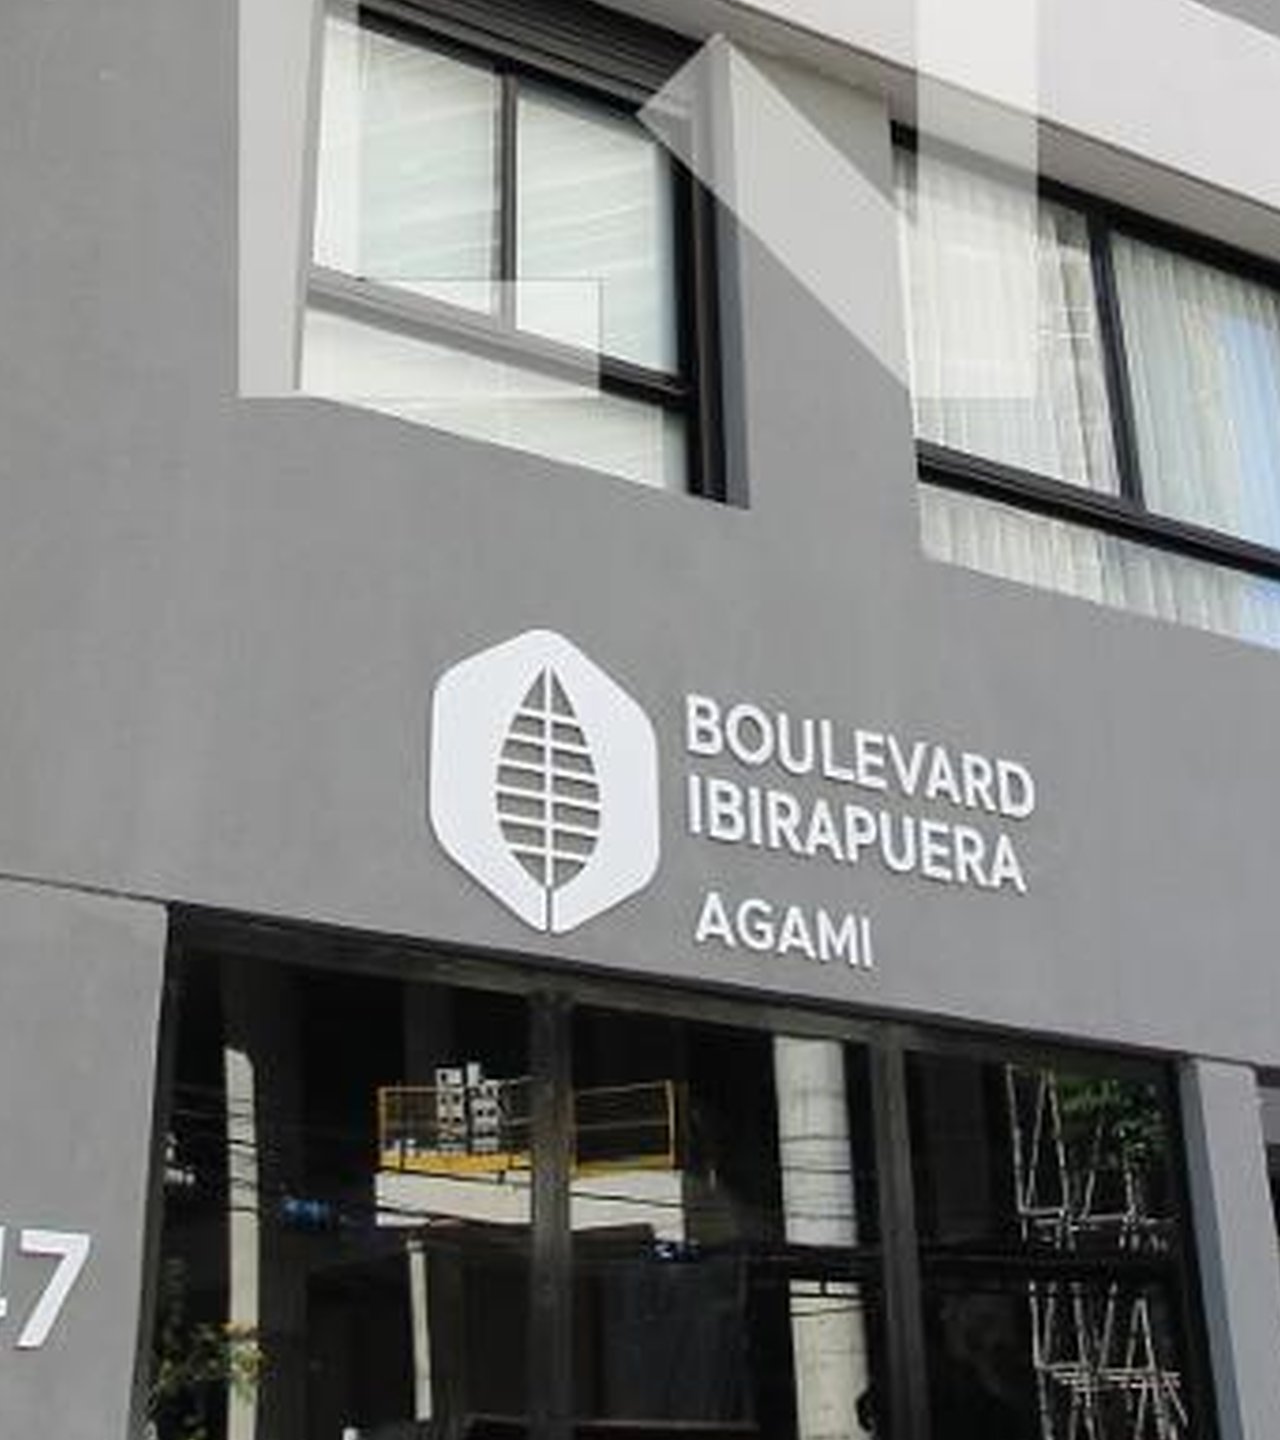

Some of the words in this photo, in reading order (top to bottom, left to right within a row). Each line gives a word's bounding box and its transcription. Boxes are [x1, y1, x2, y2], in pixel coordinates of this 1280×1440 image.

[684, 691, 1037, 820] BOULEVARD
[687, 771, 1028, 894] IBIRAPUERA
[694, 890, 875, 970] AGAMI
